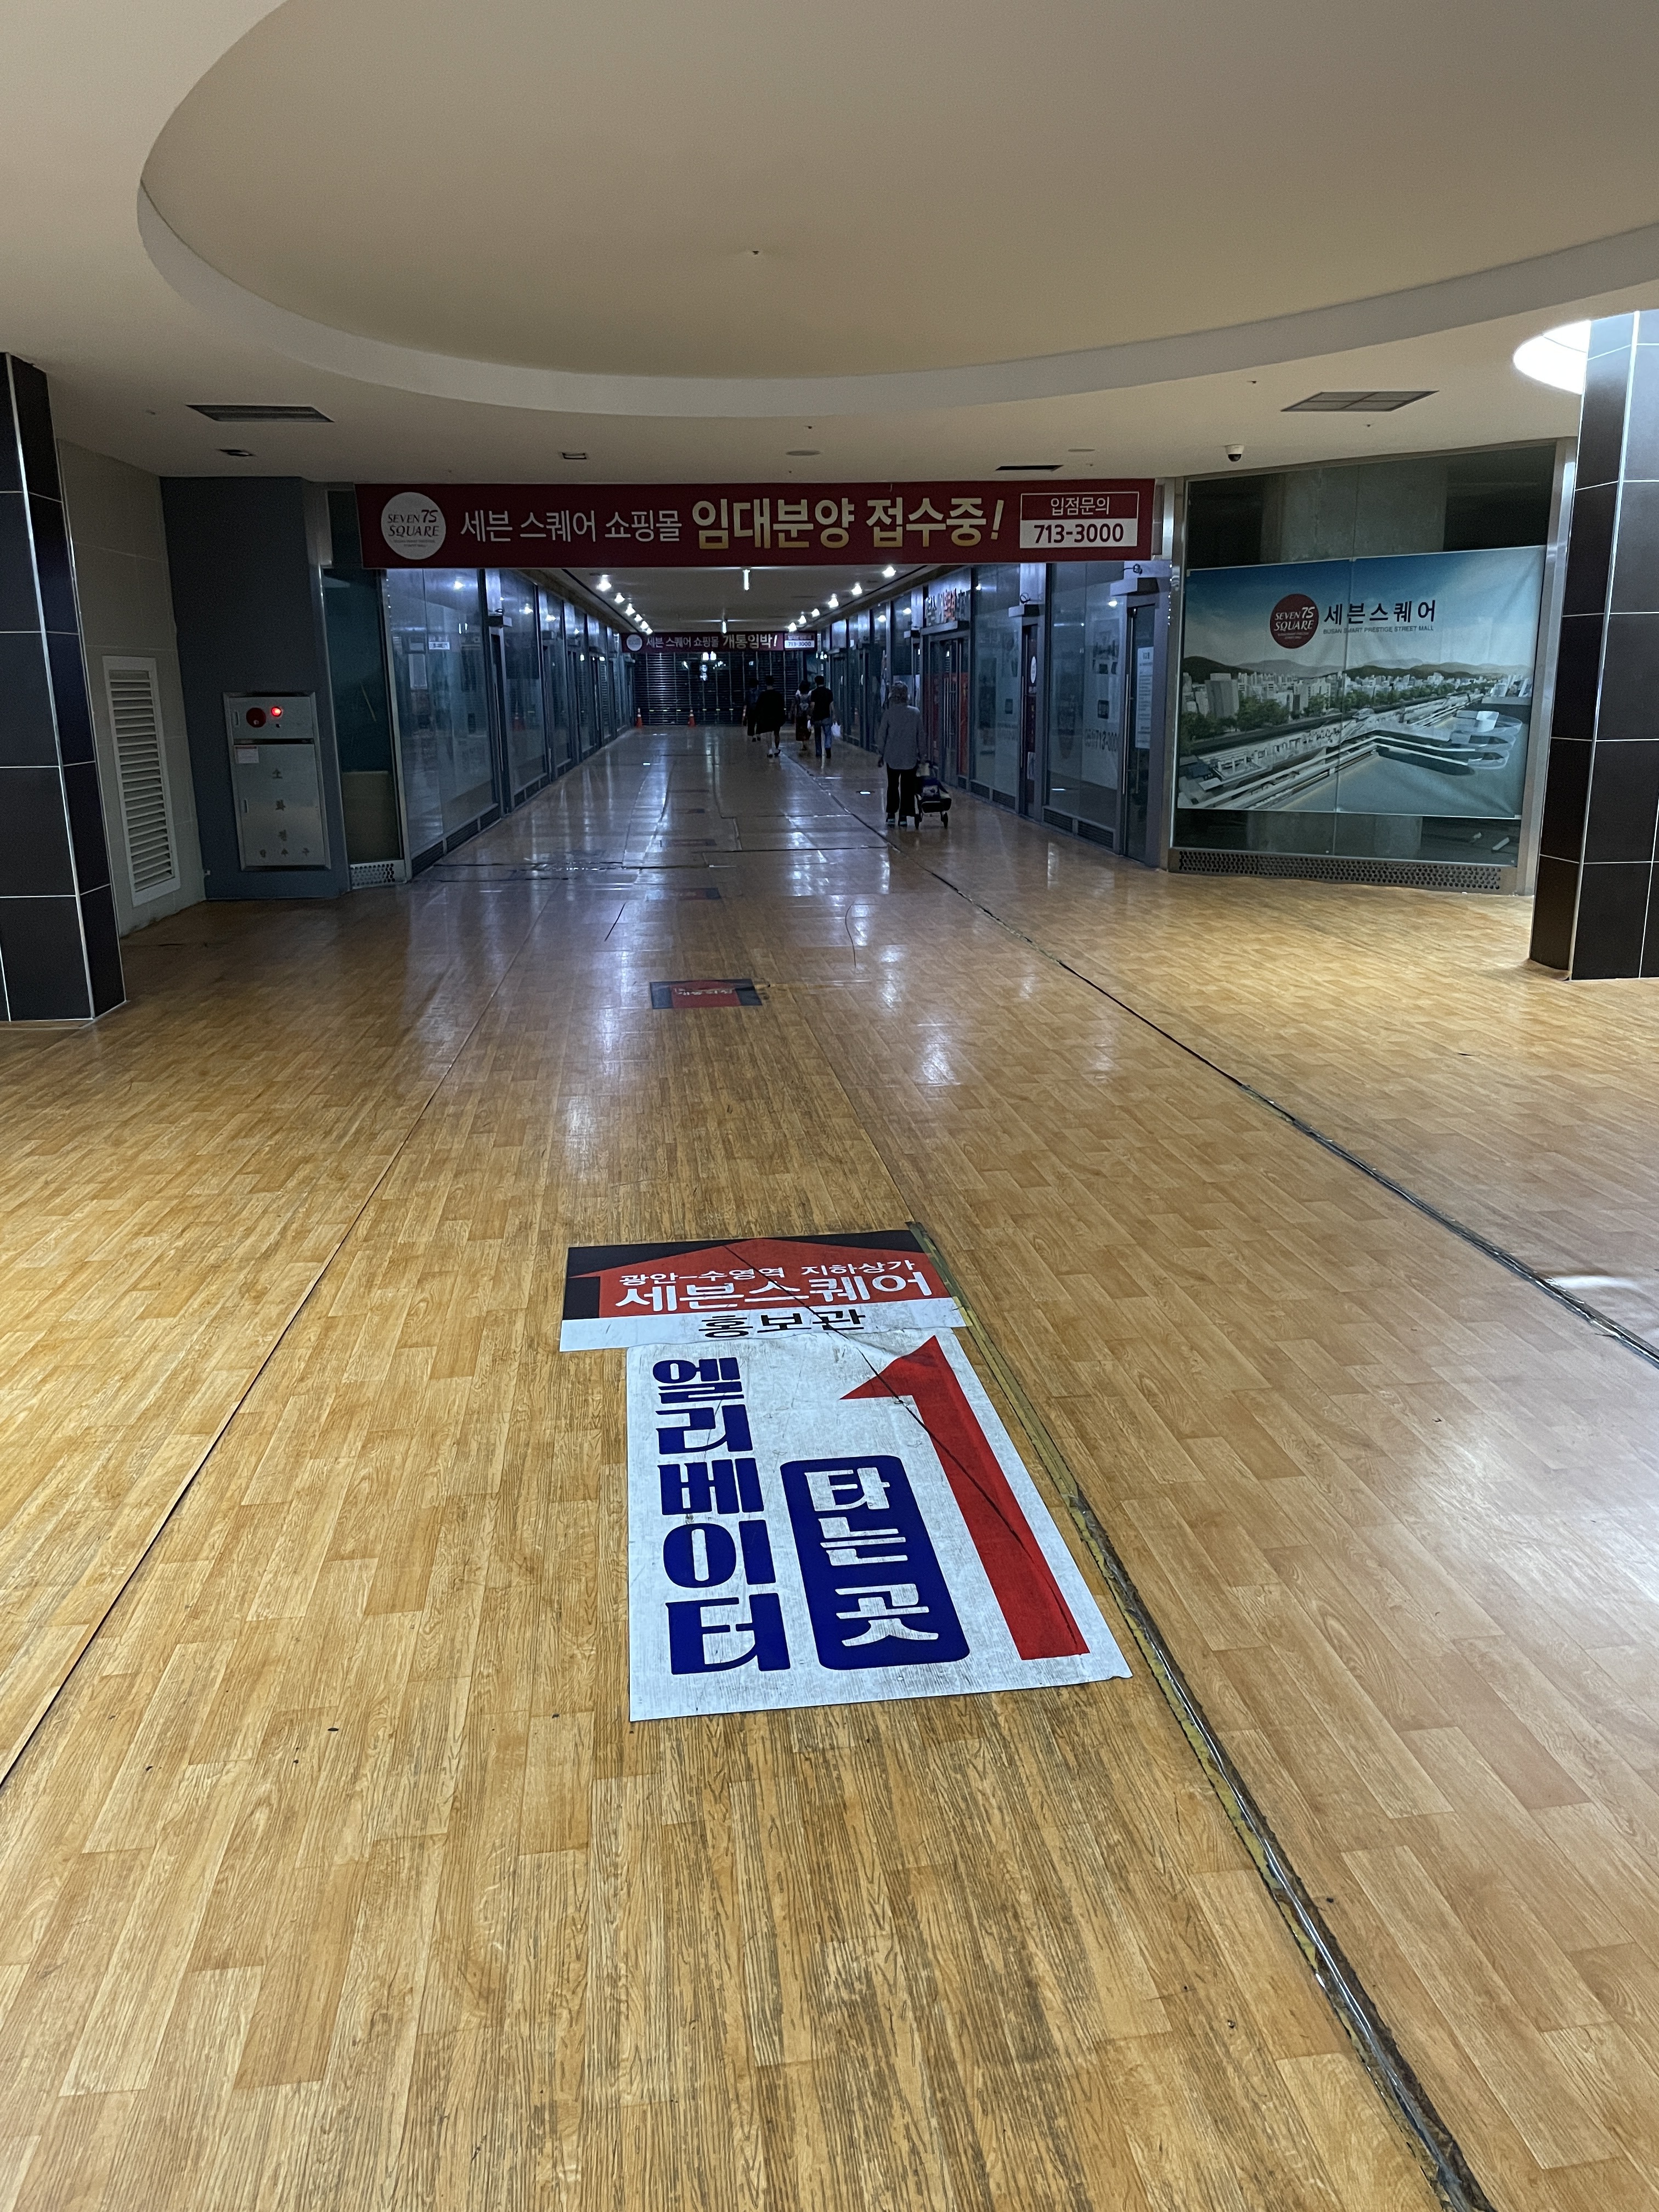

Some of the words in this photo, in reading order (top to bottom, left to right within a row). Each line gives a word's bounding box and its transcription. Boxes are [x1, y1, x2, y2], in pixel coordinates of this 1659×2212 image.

[1051, 496, 1110, 516] 입점문의
[387, 514, 420, 523] SEVEN
[460, 510, 513, 542] 세븐
[520, 509, 596, 542] 스퀘어
[605, 509, 682, 542] 쇼핑몰
[692, 498, 854, 549] 임대분양
[866, 497, 1004, 548] 접수중!
[388, 524, 439, 537] SQUARE
[1034, 523, 1124, 544] 713-3000
[1274, 612, 1300, 620] SEVEN
[1324, 600, 1436, 625] 세븐스퀘어
[1274, 619, 1314, 631] SQUARE
[646, 636, 663, 648] 세븐
[665, 636, 691, 648] 스퀘어
[693, 636, 719, 648] 쇼핑몰
[801, 1260, 916, 1276] 지하상가
[615, 1271, 933, 1312] 세븐스퀘어
[698, 1308, 866, 1338] 홍보관
[652, 1357, 791, 1675] 엘리베이터
